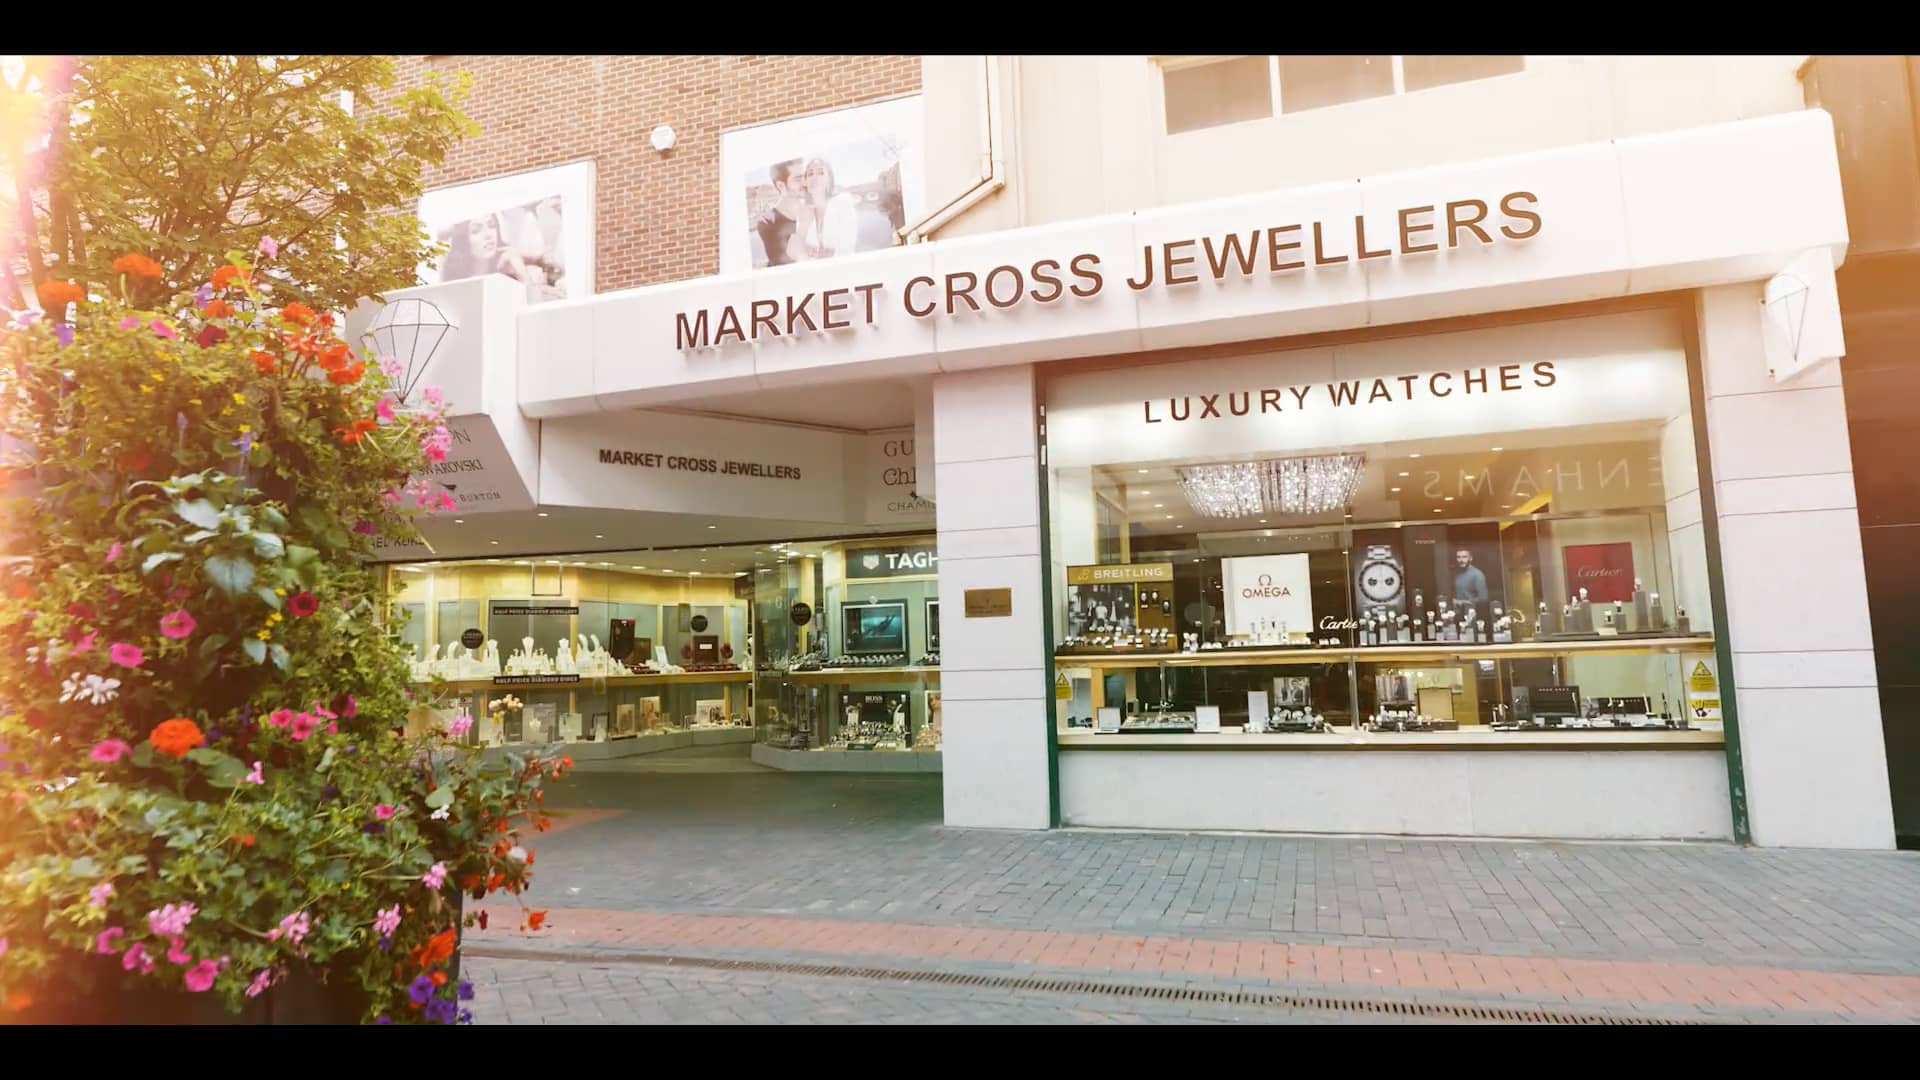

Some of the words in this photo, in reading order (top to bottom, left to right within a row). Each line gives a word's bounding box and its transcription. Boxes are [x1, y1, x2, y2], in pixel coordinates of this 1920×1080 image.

[676, 282, 884, 351] MARKET
[903, 253, 1104, 318] CROSS
[1126, 190, 1543, 291] JEWELLERS
[1143, 385, 1312, 424] LUXURY
[1328, 361, 1557, 408] WATCHES
[599, 448, 663, 468] MARKET
[667, 455, 717, 473] CROSS
[721, 460, 801, 480] JEWELLERS
[459, 491, 502, 503] BURTON
[1093, 566, 1164, 580] BREITLING
[1242, 586, 1292, 599] OMEGA
[1319, 615, 1359, 631] Cartie
